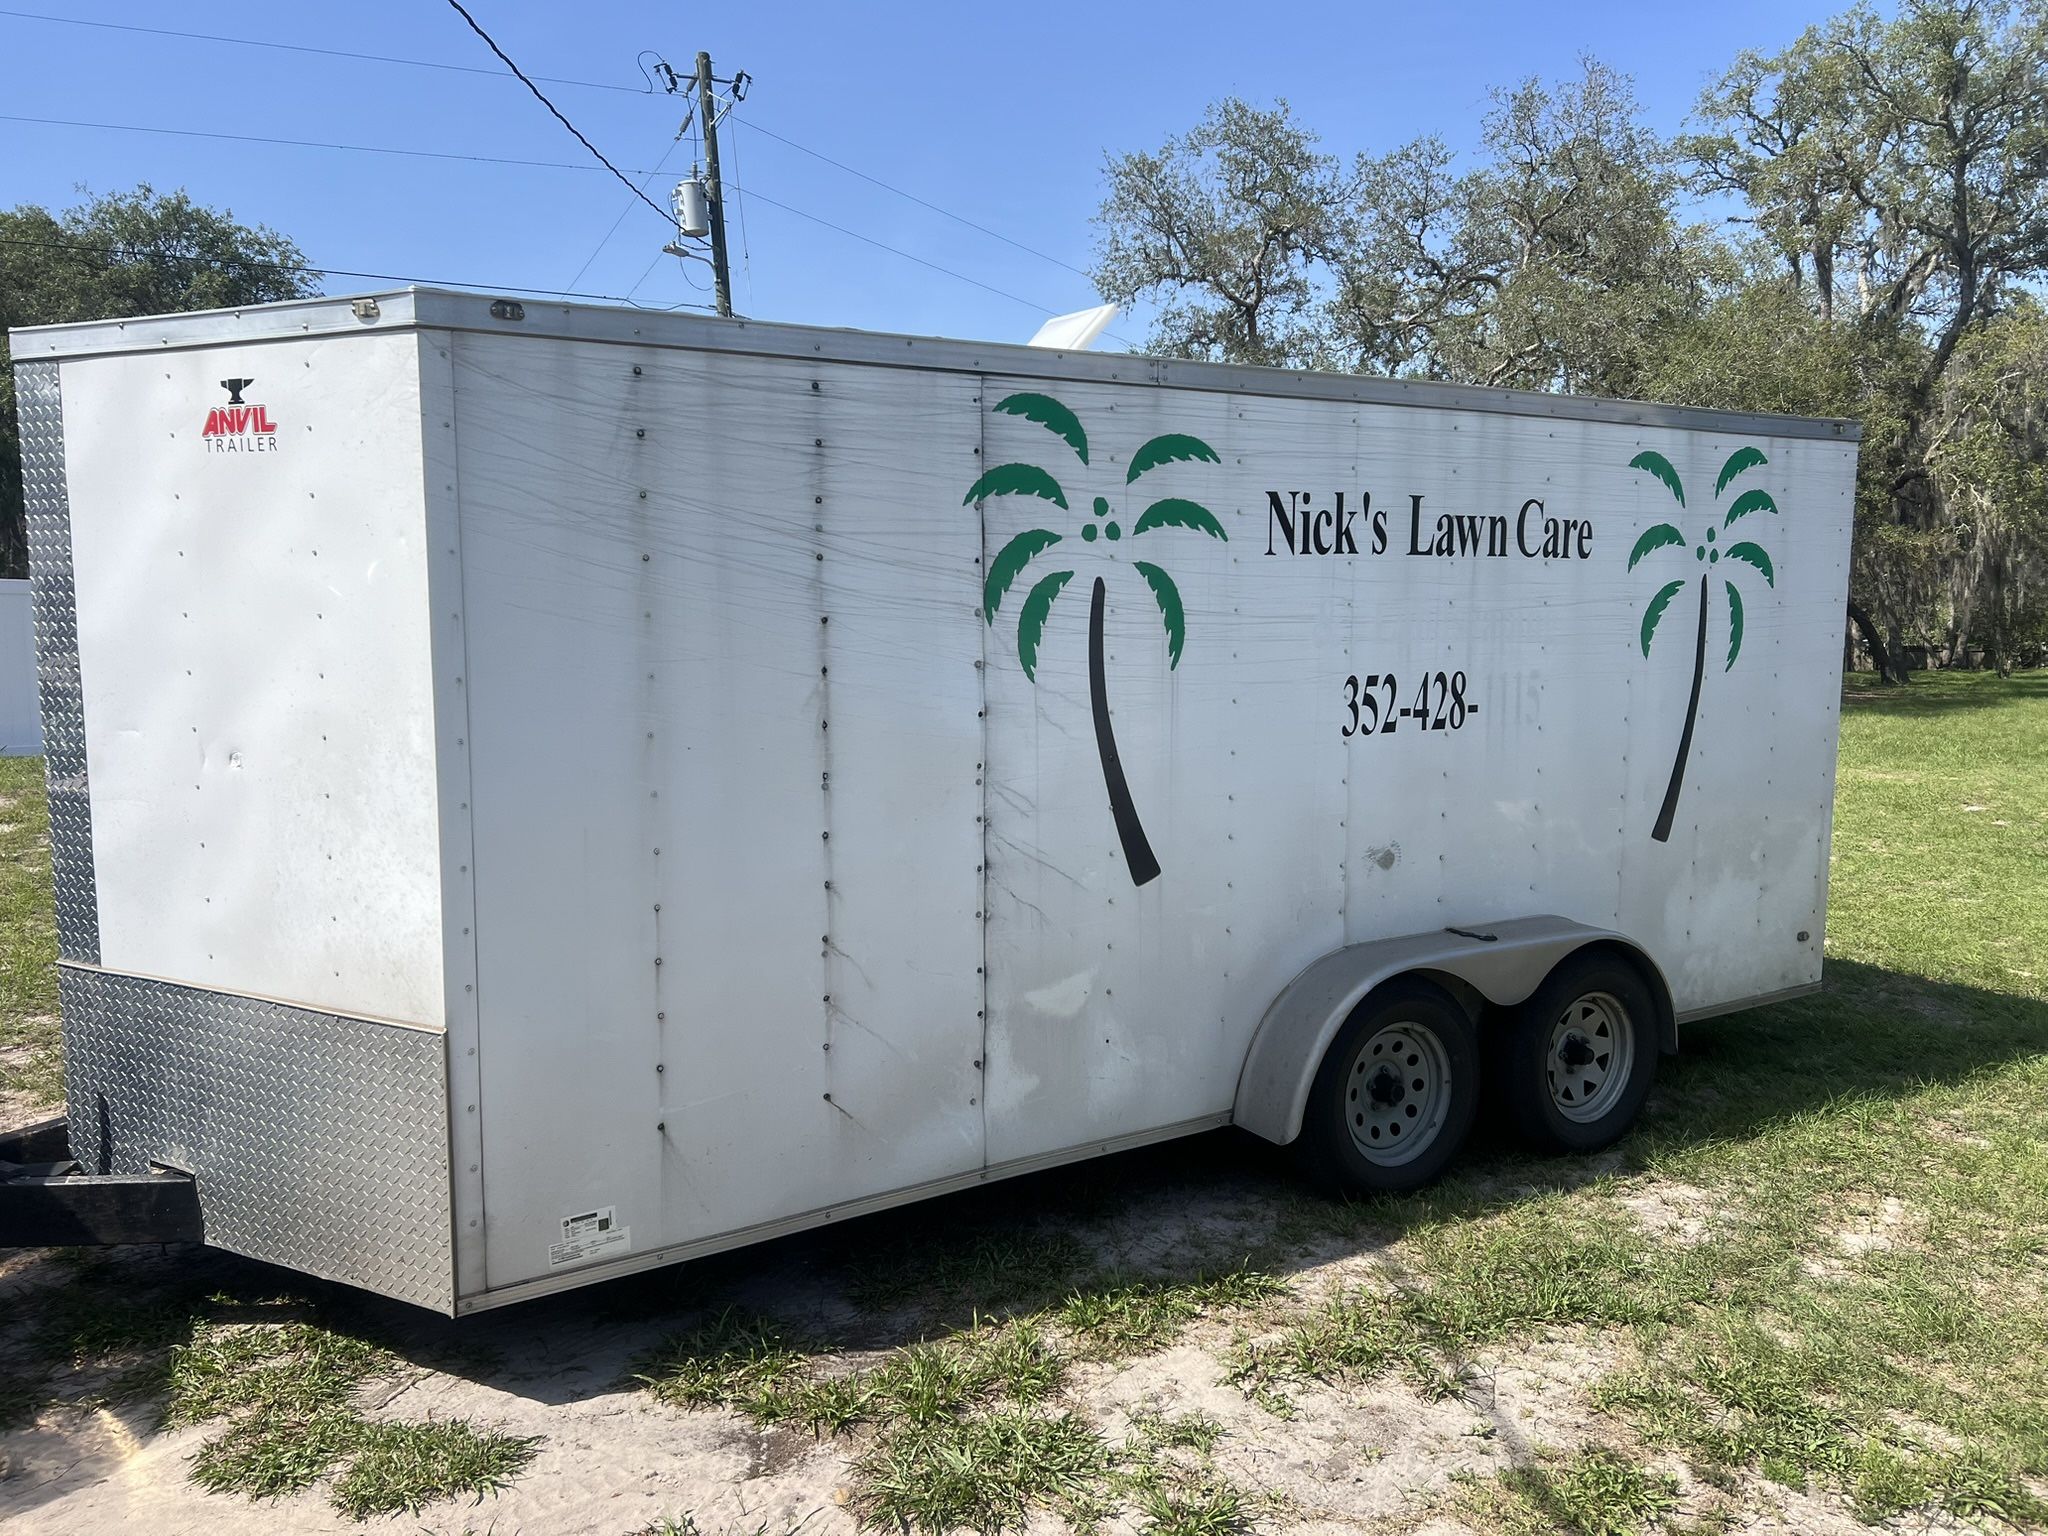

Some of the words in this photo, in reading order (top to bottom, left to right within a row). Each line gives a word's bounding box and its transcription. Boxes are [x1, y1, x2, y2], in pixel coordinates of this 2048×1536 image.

[202, 404, 278, 438] ANVIL
[204, 437, 277, 453] TRAILER
[1264, 490, 1388, 556] Nick's
[1406, 494, 1508, 557] Lawn
[1516, 498, 1593, 560] Care
